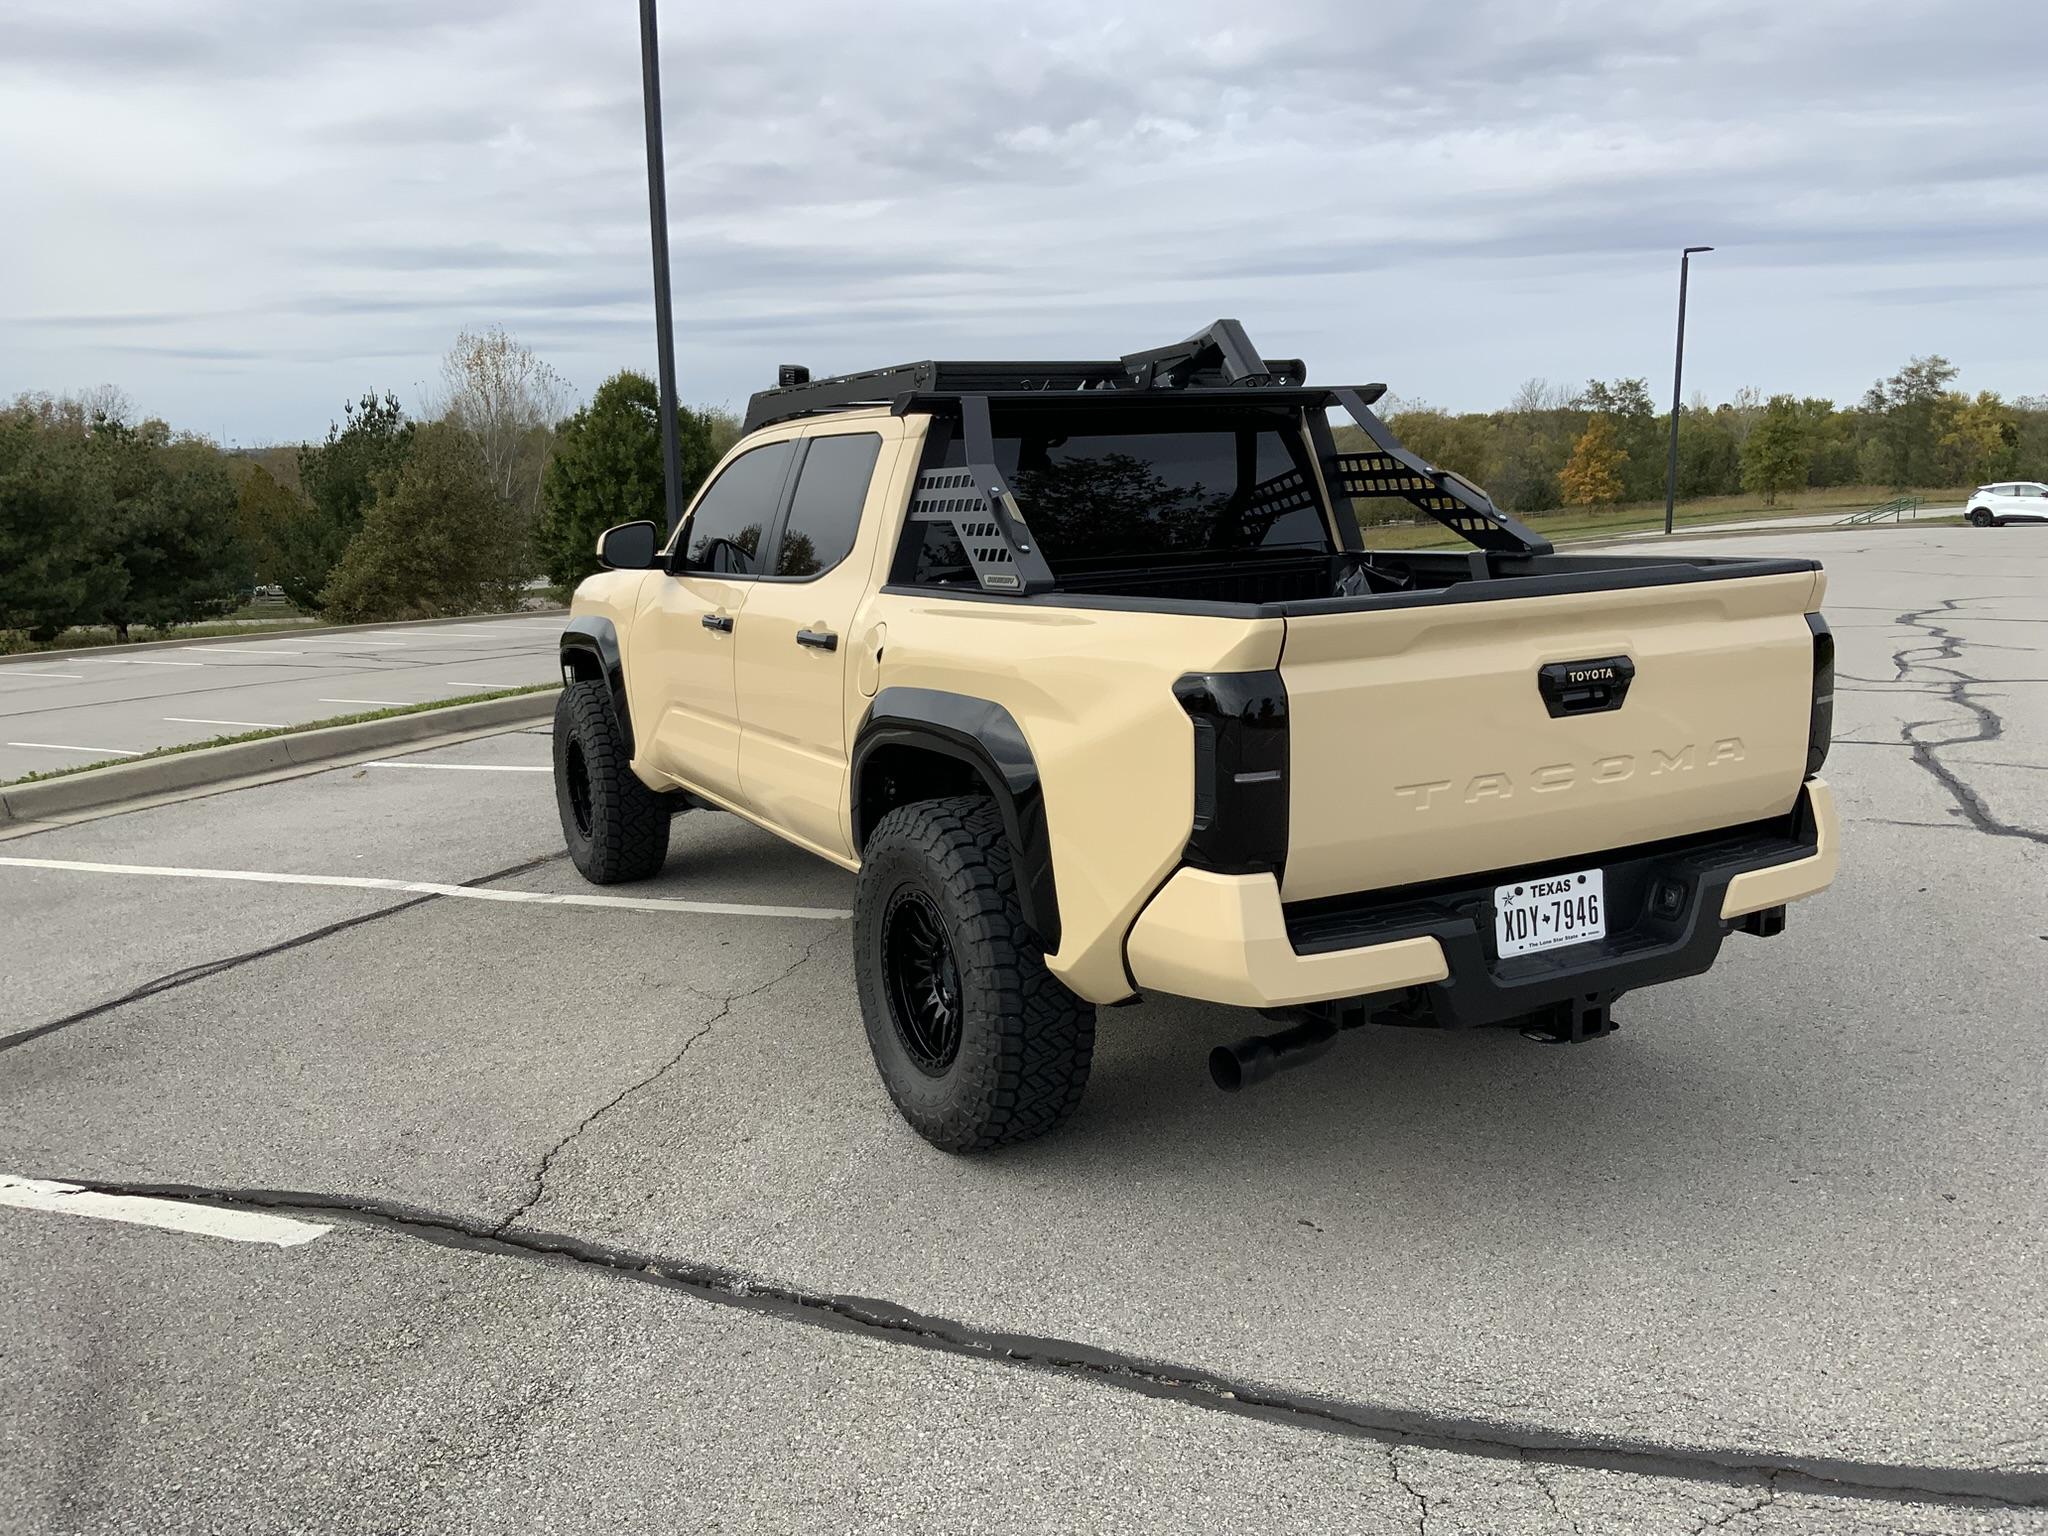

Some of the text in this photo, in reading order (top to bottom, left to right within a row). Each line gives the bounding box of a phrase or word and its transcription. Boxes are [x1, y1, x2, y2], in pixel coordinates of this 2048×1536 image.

[1569, 668, 1614, 682] TOYOTA
[1394, 736, 1746, 811] TACOMA
[1530, 880, 1571, 898] TEXAS
